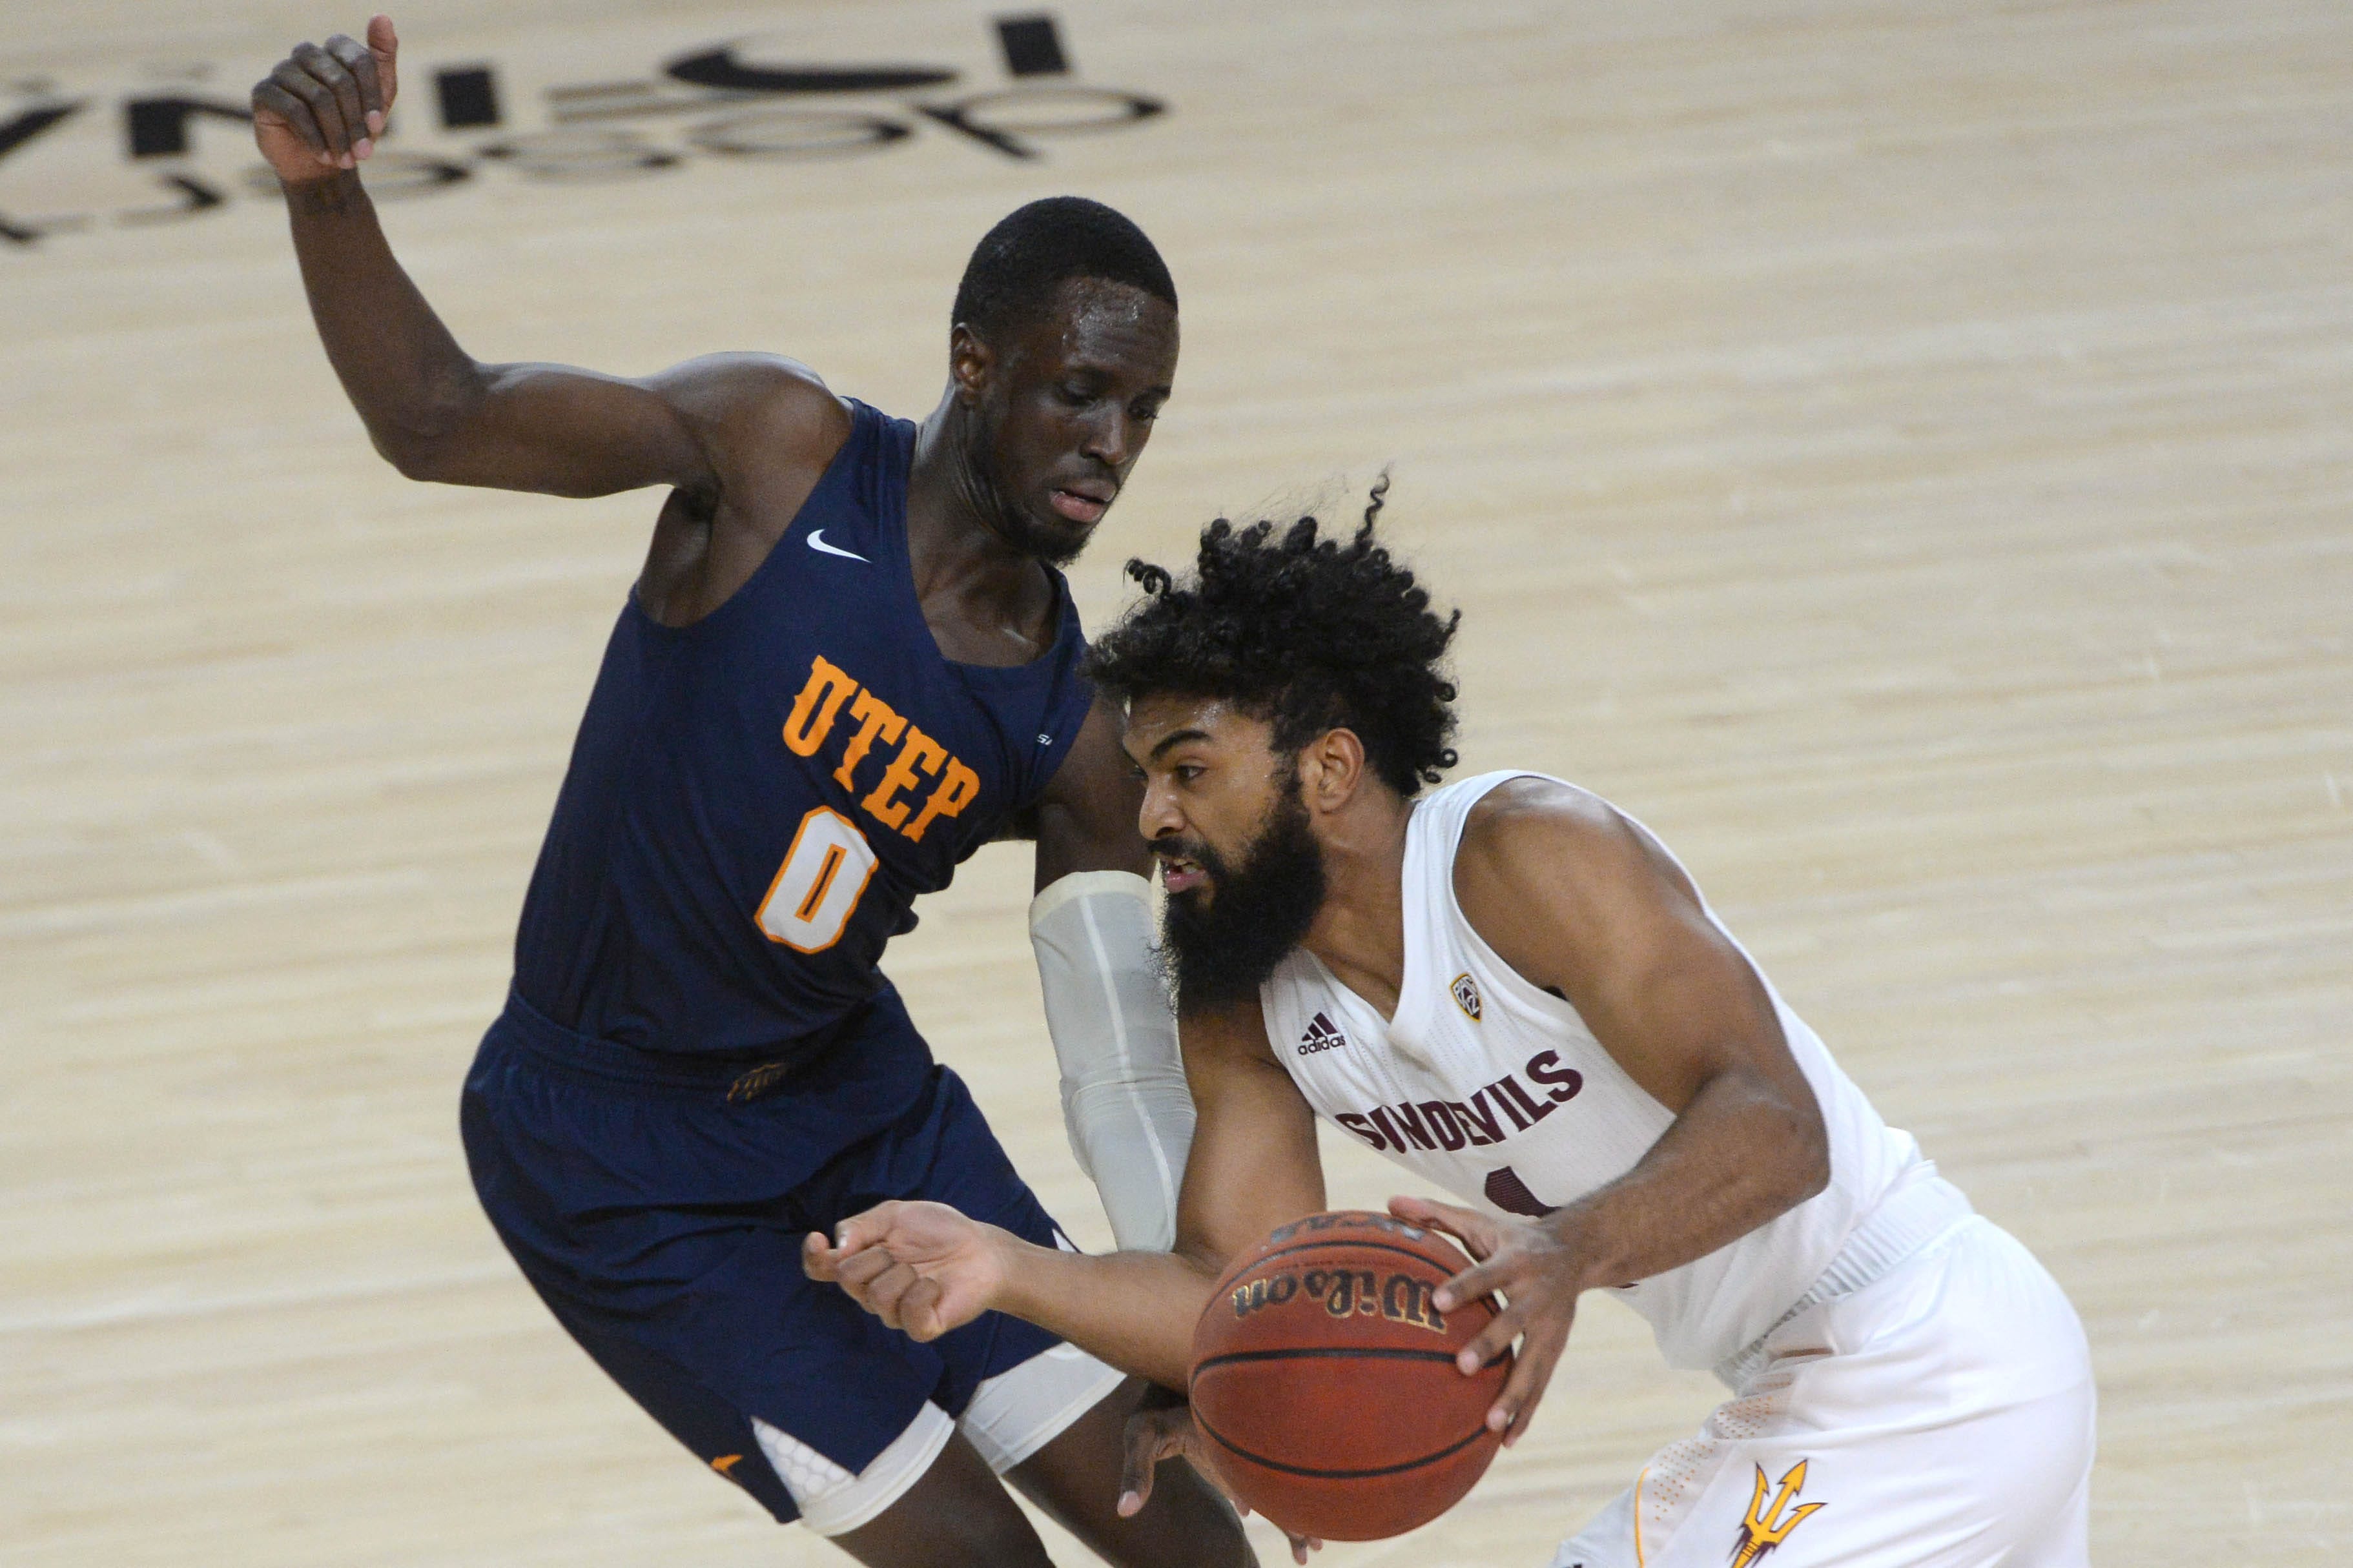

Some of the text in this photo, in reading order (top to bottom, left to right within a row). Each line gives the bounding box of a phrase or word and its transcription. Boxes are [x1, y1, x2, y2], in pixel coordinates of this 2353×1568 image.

[783, 655, 980, 842] UTEP
[755, 805, 878, 954] 0
[1298, 1035, 1346, 1055] adidas
[1232, 1268, 1447, 1334] Wilson
